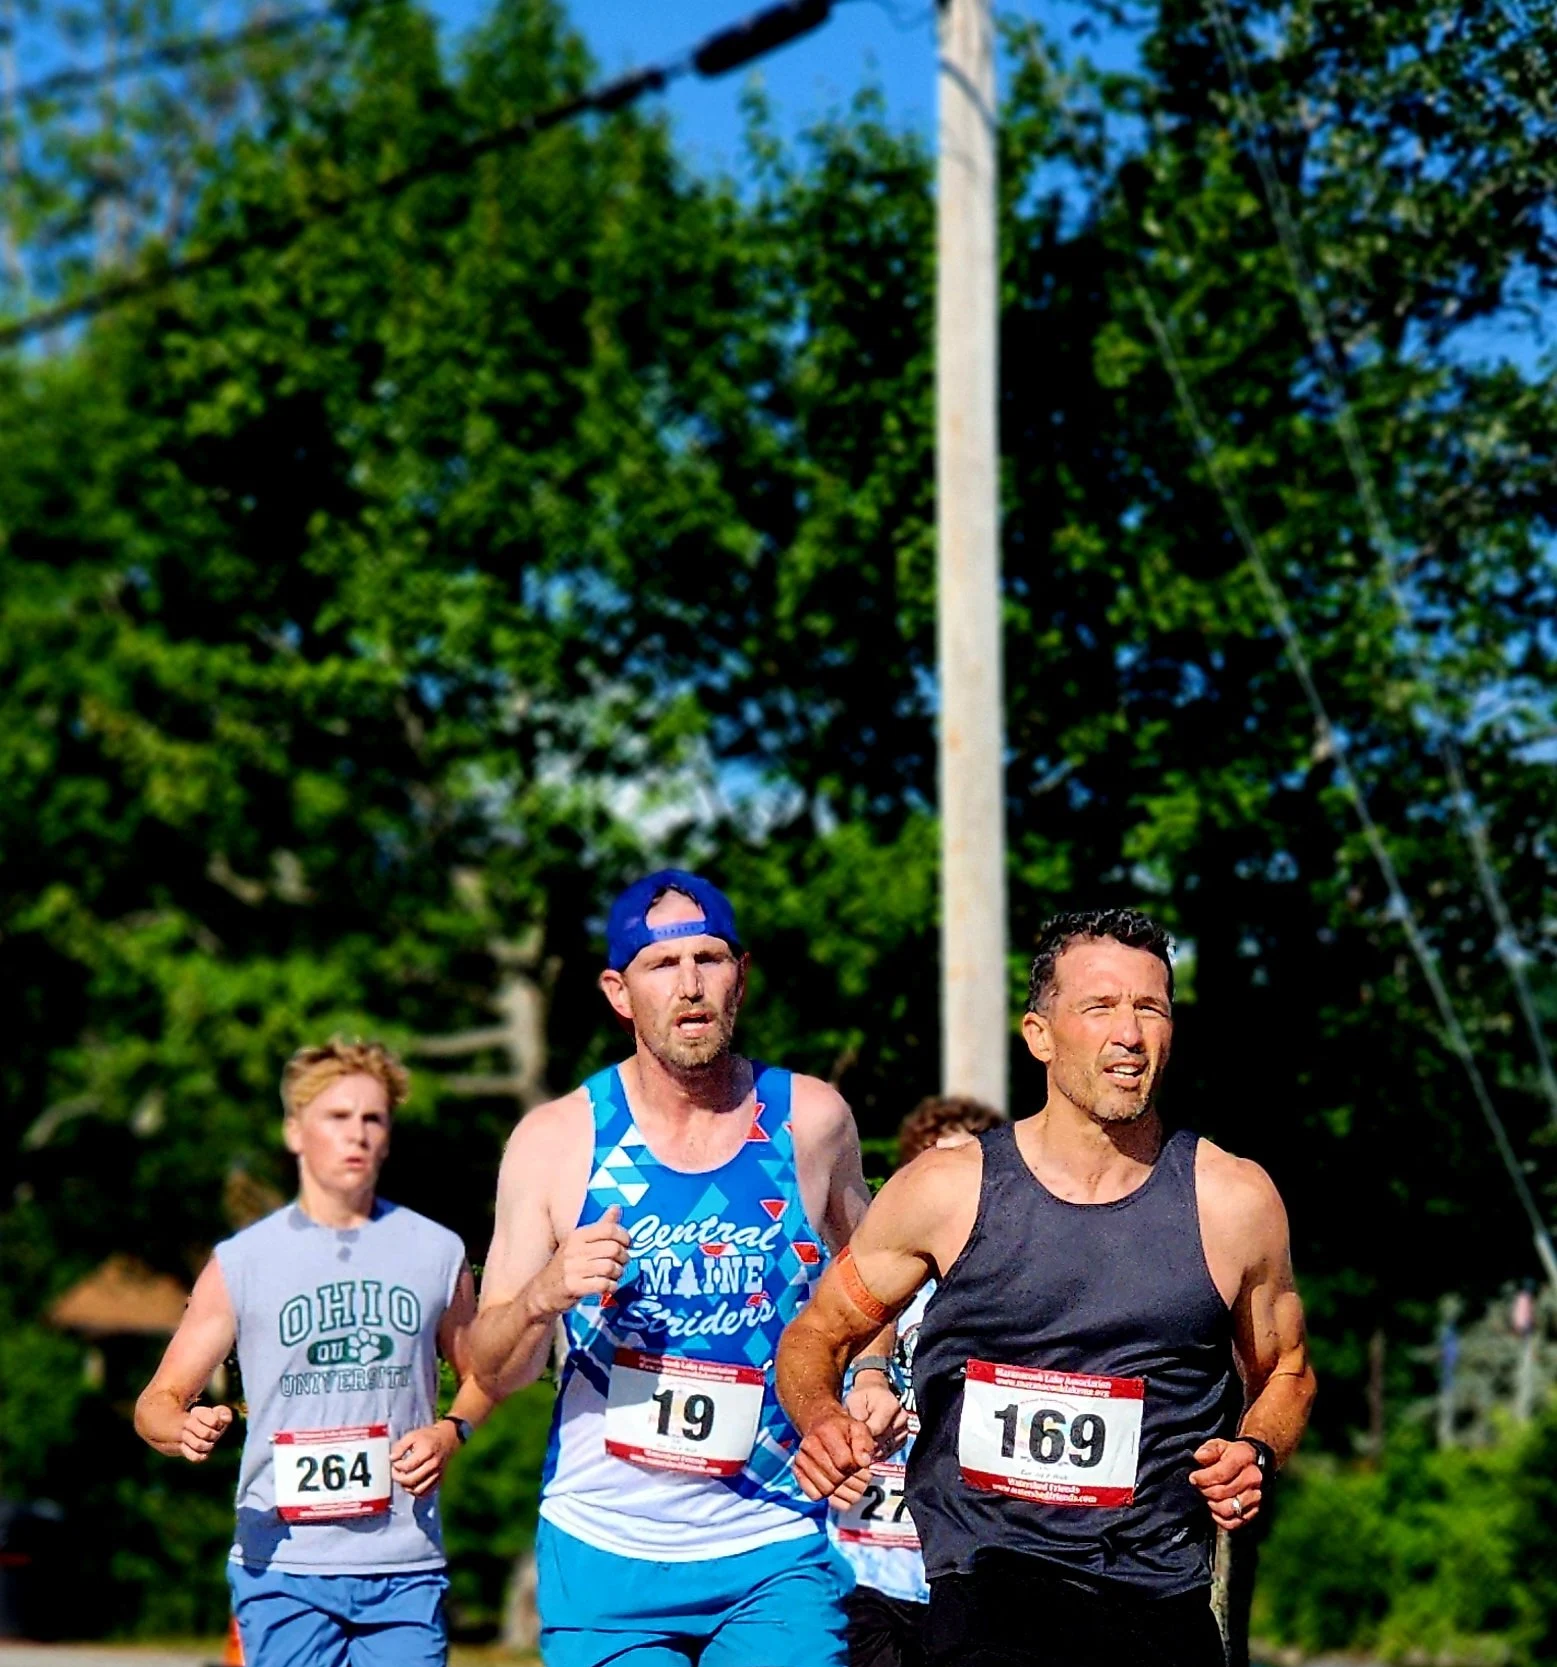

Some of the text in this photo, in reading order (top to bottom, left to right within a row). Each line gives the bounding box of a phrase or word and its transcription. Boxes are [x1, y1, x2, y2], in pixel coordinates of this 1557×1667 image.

[627, 1214, 783, 1258] Central
[280, 1280, 421, 1348] OHIO
[617, 1295, 776, 1338] Striders
[317, 1341, 344, 1361] OU
[279, 1364, 413, 1397] UNIVERSITY
[1044, 1374, 1065, 1385] Lake
[1066, 1377, 1112, 1390] Association
[652, 1389, 715, 1441] 19
[994, 1403, 1106, 1468] 169
[296, 1452, 372, 1492] 264
[1008, 1476, 1081, 1494] Watershed Friends
